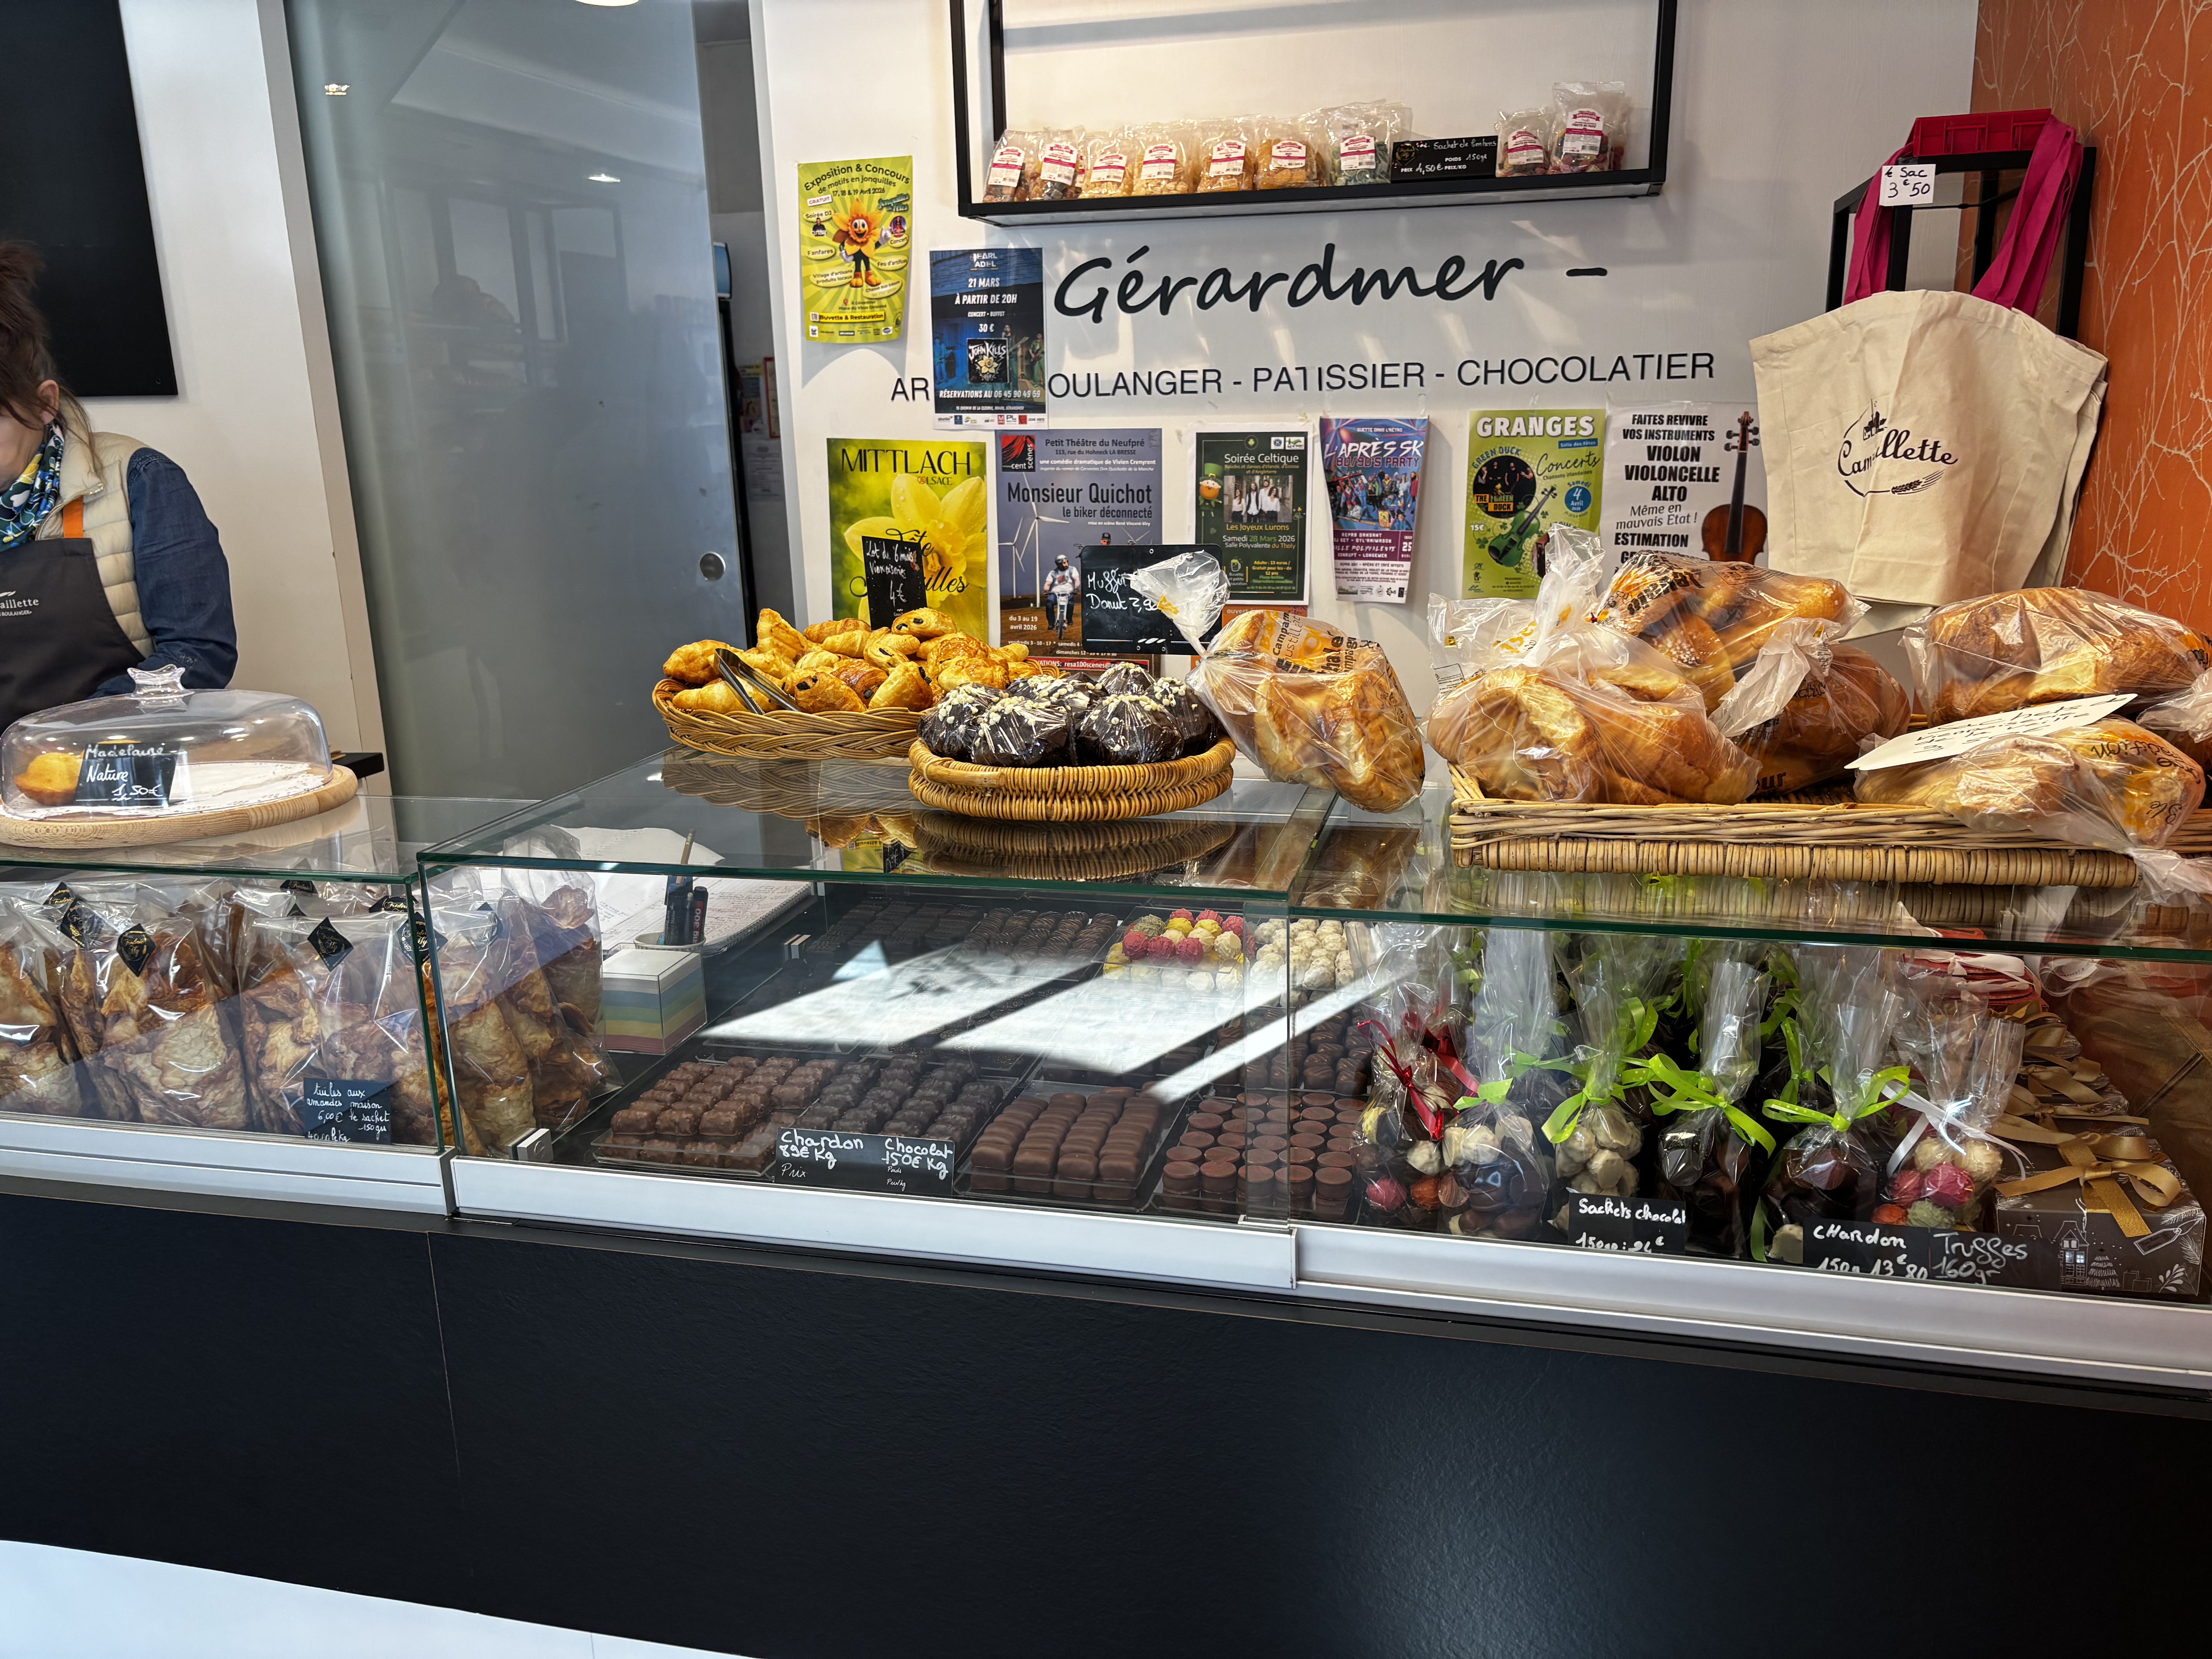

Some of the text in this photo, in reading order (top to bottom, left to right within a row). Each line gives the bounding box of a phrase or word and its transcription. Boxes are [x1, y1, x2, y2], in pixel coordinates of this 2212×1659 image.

[1434, 140, 1458, 150] Sachet
[1460, 139, 1468, 147] de
[804, 164, 910, 191] Exposition Concours
[1899, 167, 1927, 177] Sac
[828, 177, 849, 189] motifs
[861, 175, 896, 187] jonquilles
[805, 211, 823, 219] Soirée
[968, 278, 1000, 288] 21 MARS
[1054, 243, 1524, 323] Gérardmer
[955, 293, 1017, 304] À PARTIR DE 20H
[979, 324, 994, 332] 30 €
[1049, 369, 1221, 398] OULANGER
[1458, 353, 1713, 386] CHOCOLATIER
[939, 389, 982, 398] RÉSERVATIONS
[1477, 416, 1594, 437] GRANGES
[1632, 414, 1708, 426] FAITES REVIVRE
[1623, 429, 1715, 441] VOS INSTRUMENTS
[1111, 439, 1145, 448] Neufpré
[1324, 438, 1397, 459] L'APRÈS
[842, 448, 970, 475] MITTLACH
[1224, 453, 1299, 466] Soirée Celtique
[1385, 456, 1420, 467] PARTY
[1472, 446, 1522, 469] GREEN DUCK
[1647, 445, 1701, 462] VIOLON
[1536, 451, 1601, 476] Concerts
[1625, 465, 1720, 483] VIOLONCELLE
[1008, 482, 1152, 503] Monsieur Quichot
[1573, 488, 1582, 500] 4
[1652, 485, 1687, 502] ALTO
[1063, 505, 1152, 519] le biker déconnecté
[1630, 504, 1681, 517] Même en
[1616, 514, 1691, 530] mauvais Etat
[1402, 542, 1412, 551] 25
[1614, 532, 1689, 548] ESTIMATION
[895, 544, 898, 562] 6
[1086, 592, 1127, 610] Donut
[86, 763, 129, 782] Nature
[313, 1082, 366, 1098] tuiles aux
[307, 1098, 342, 1106] amandes
[349, 1108, 358, 1121] le
[362, 1111, 390, 1121] sachet
[781, 1129, 864, 1150] Chardon
[885, 1138, 953, 1159] Chocolat
[782, 1163, 807, 1178] Prix
[1579, 1197, 1685, 1225] Sachets chocolat
[1933, 1232, 2028, 1269] Truffes
